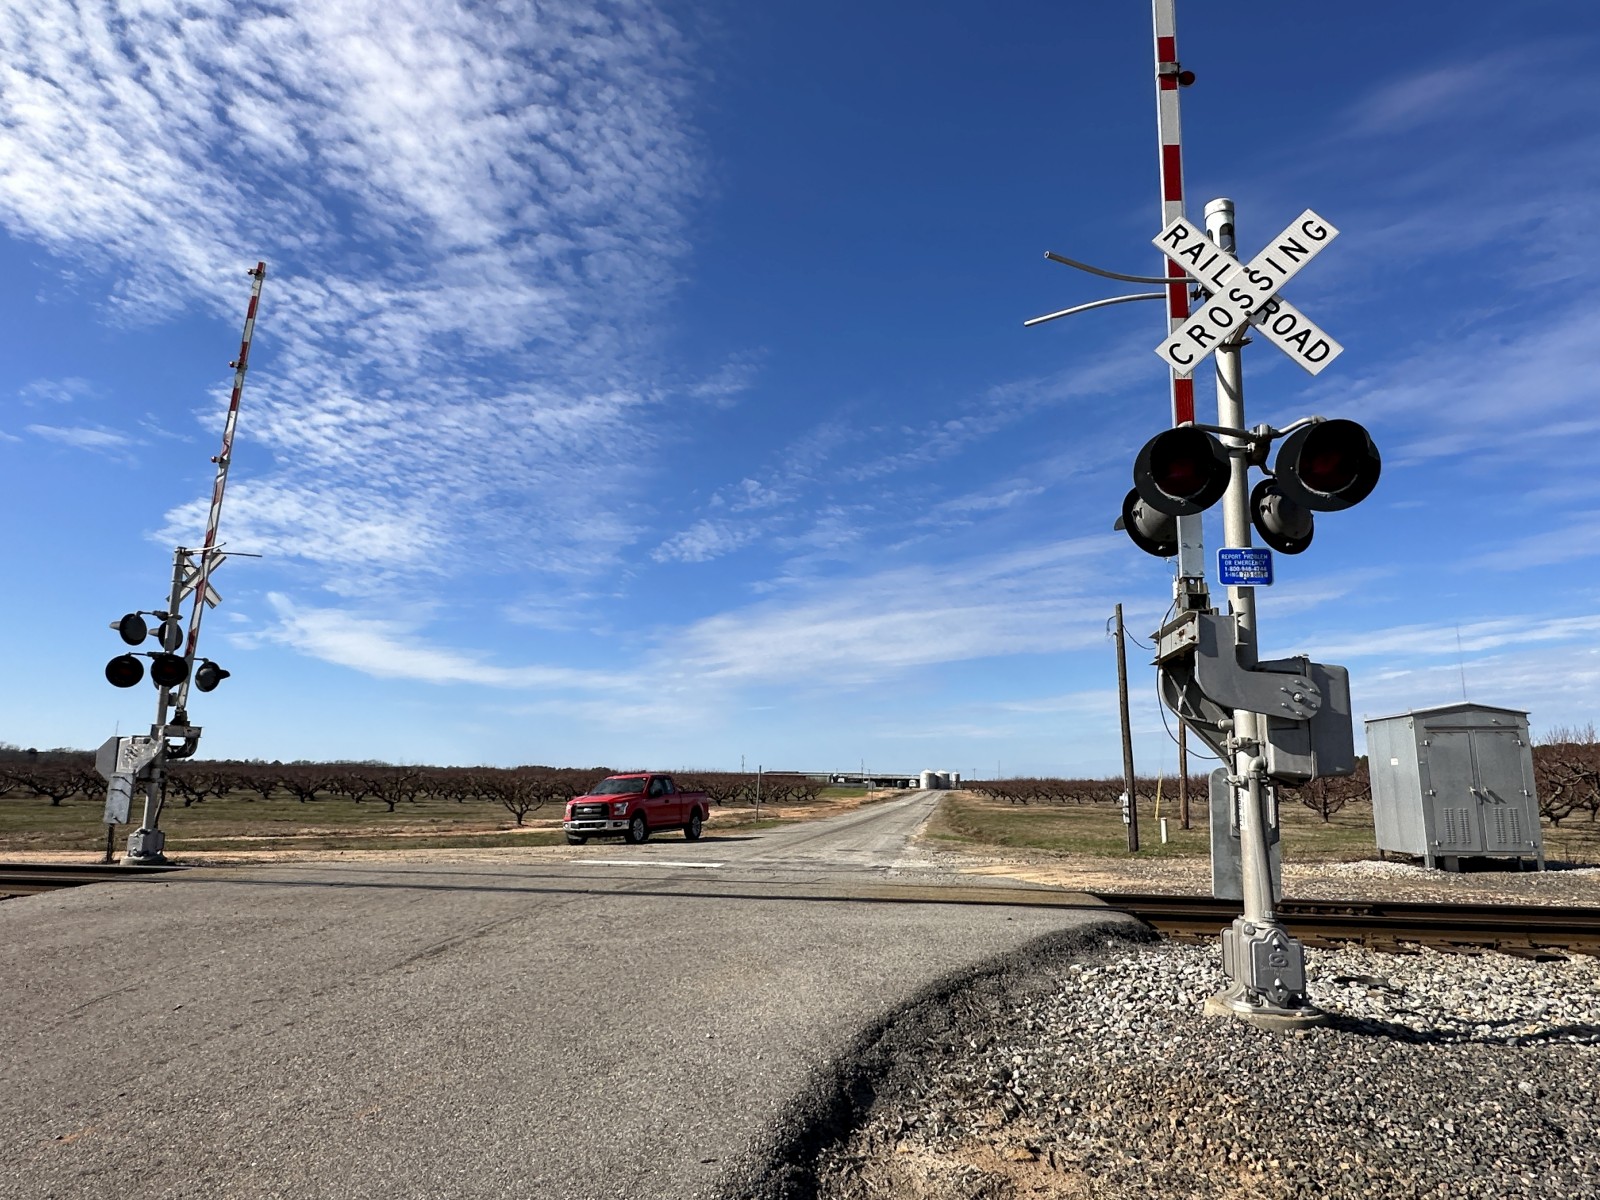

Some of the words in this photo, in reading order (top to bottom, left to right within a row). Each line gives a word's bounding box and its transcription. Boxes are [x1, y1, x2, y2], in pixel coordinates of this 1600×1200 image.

[1162, 223, 1231, 288] RAIL
[1253, 297, 1330, 363] ROAD
[1168, 220, 1328, 365] CROSSING
